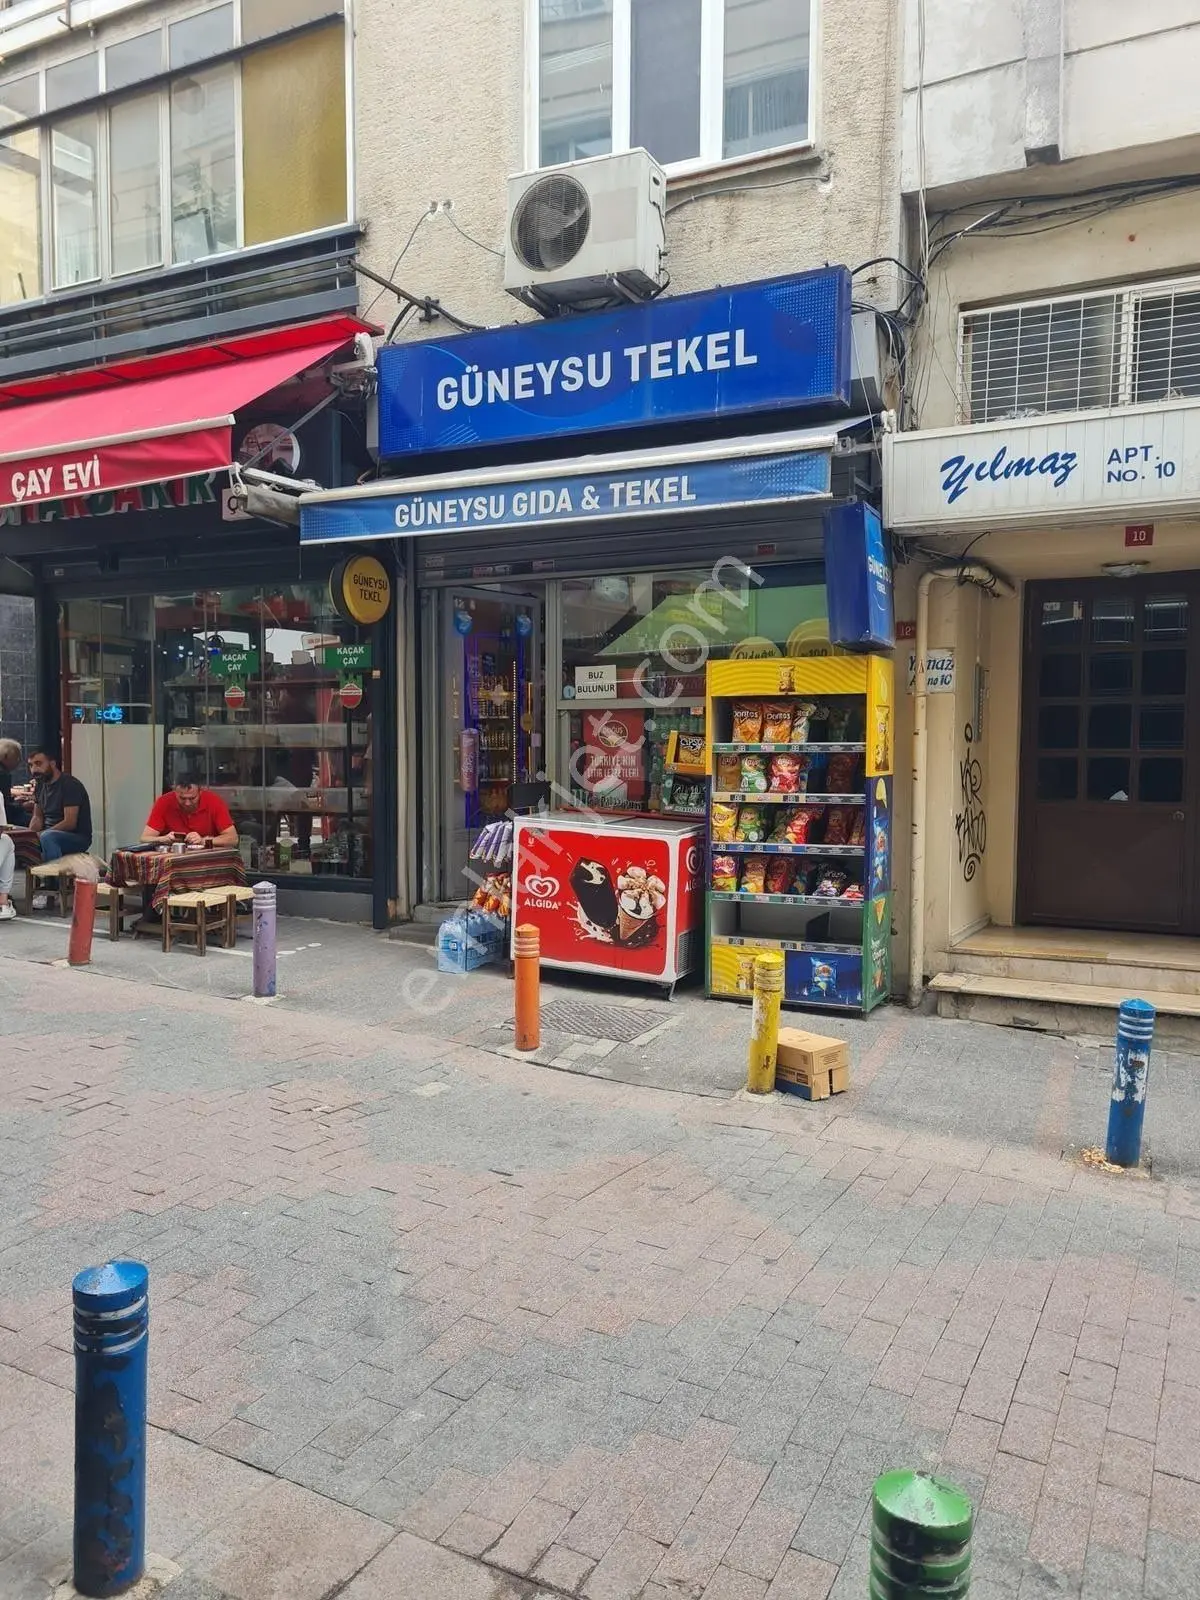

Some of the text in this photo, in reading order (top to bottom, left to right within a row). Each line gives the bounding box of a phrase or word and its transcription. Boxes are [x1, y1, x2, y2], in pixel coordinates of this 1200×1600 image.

[437, 328, 757, 411] GÜNEYSU TEKEL
[1107, 445, 1160, 465] APT.
[11, 454, 101, 501] ÇAY EVİ
[1107, 461, 1176, 483] NO. 10
[394, 475, 697, 527] GÜNEYSU GIDA & TEKEL
[1132, 530, 1147, 542] 10
[353, 573, 388, 590] GÜNEYSU
[359, 588, 382, 603] TEKEL
[222, 653, 247, 663] KAÇAK
[337, 646, 365, 657] KAÇAK
[227, 663, 242, 673] ÇAY
[343, 656, 359, 669] ÇAY
[588, 671, 604, 679] BUZ
[940, 674, 953, 686] 10
[577, 684, 615, 693] BULUNUR
